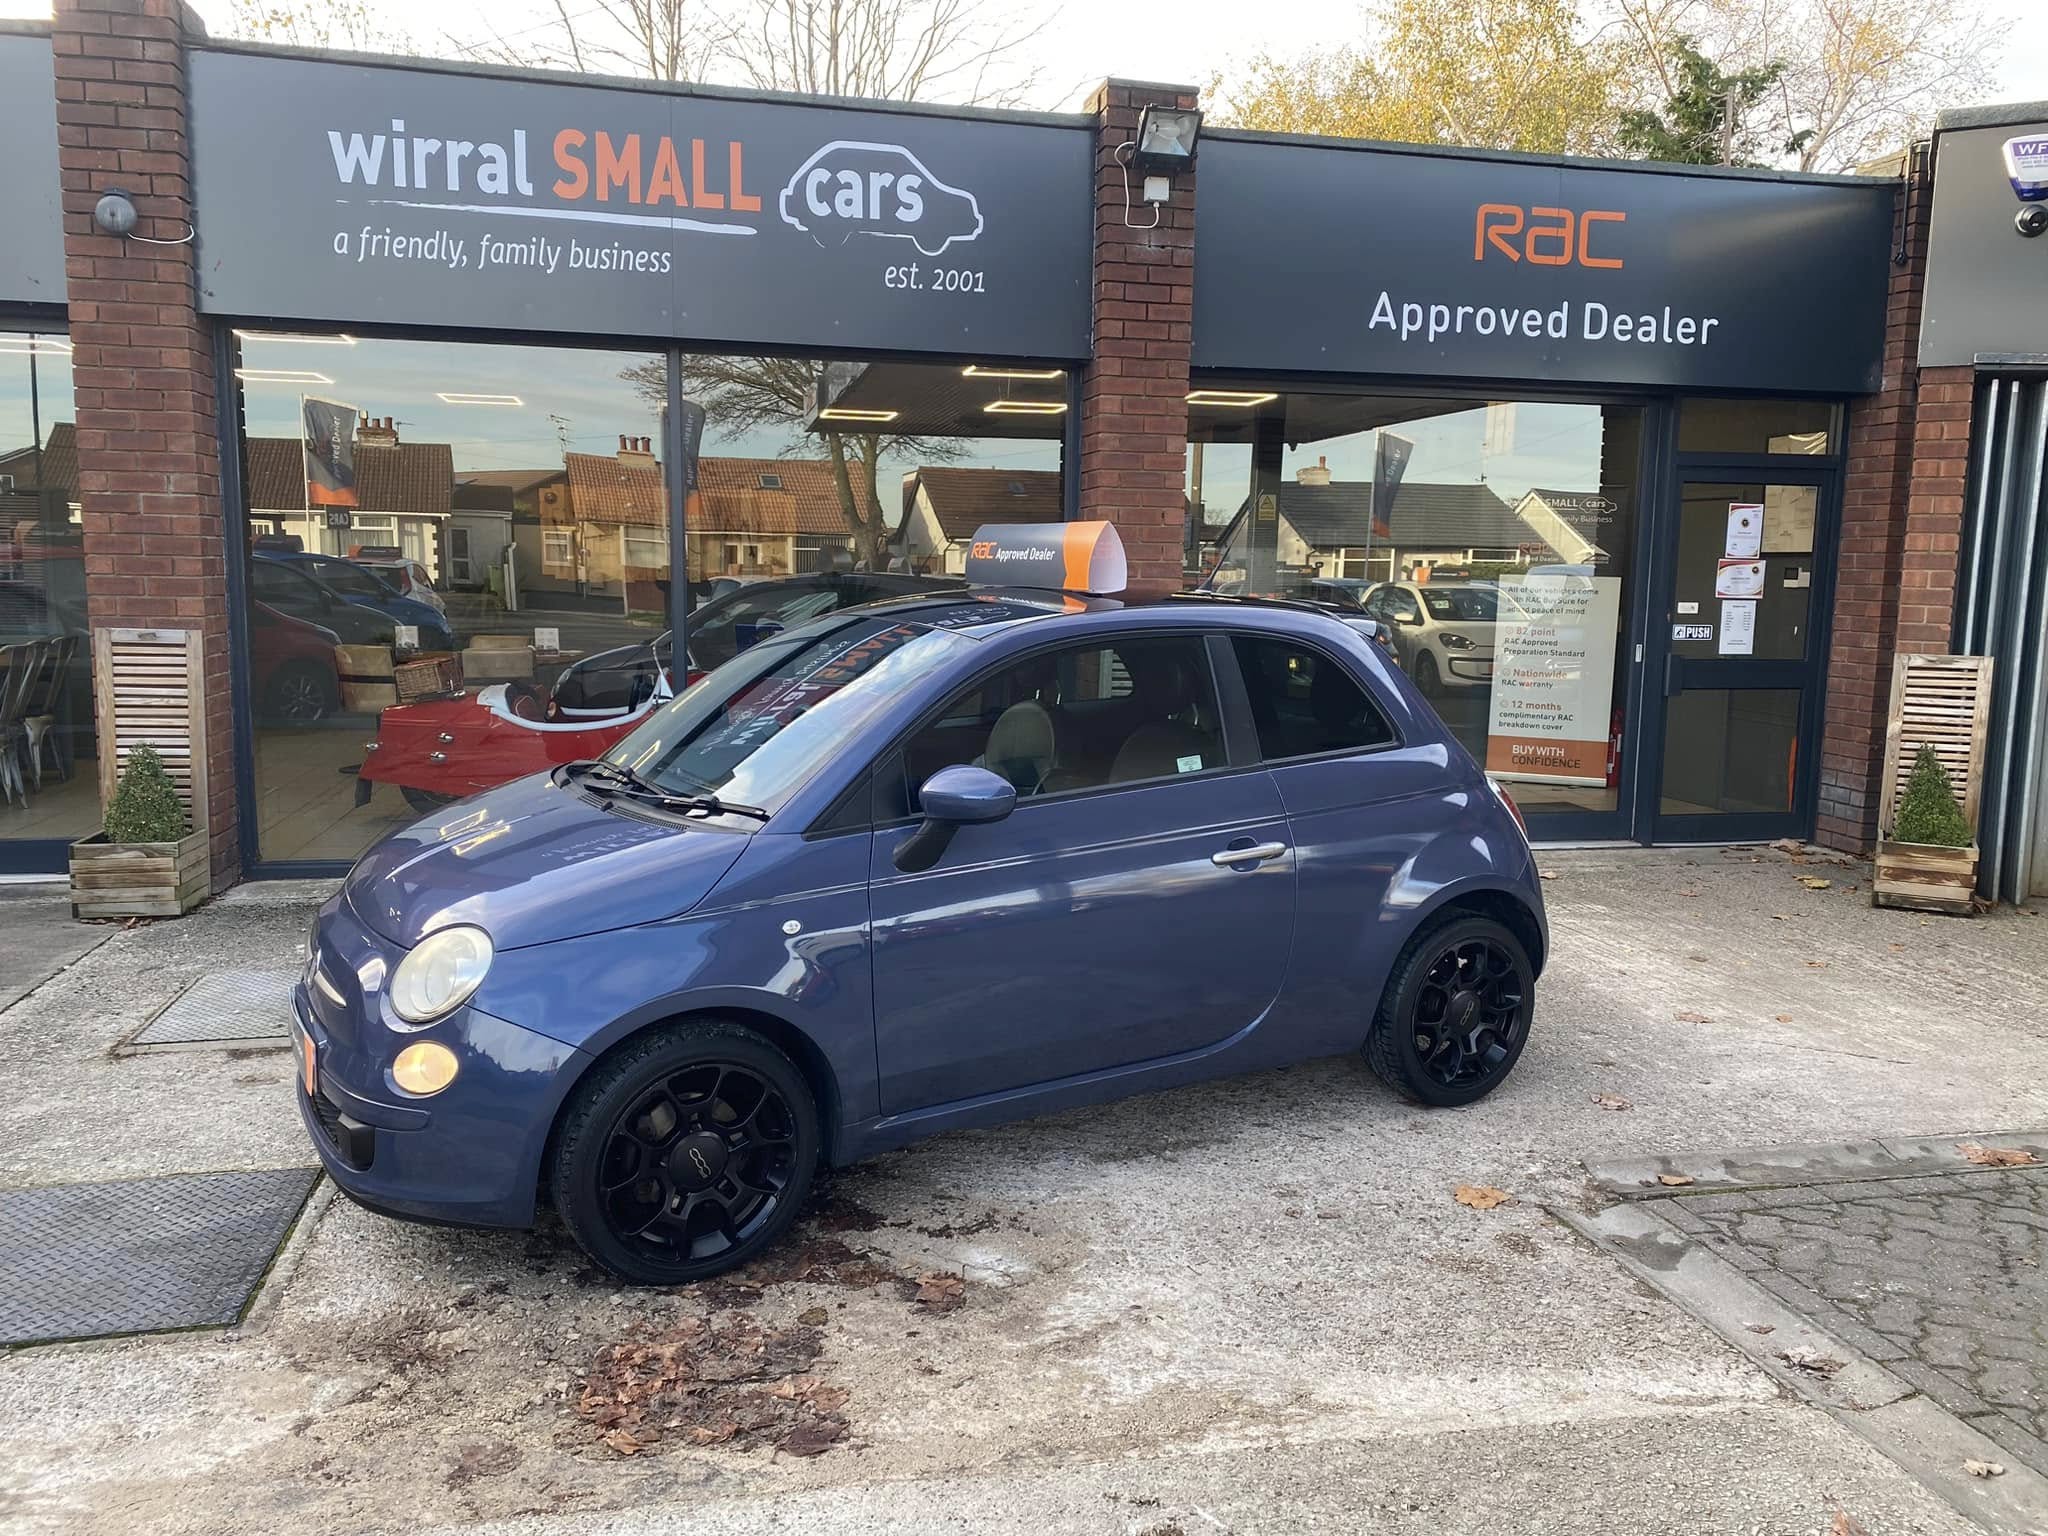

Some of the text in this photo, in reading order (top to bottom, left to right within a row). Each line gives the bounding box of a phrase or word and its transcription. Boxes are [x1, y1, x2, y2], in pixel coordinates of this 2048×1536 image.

[327, 118, 761, 212] wirral SMALL
[806, 167, 924, 222] cars
[333, 226, 672, 274] a friendly, family business
[884, 262, 985, 293] est. 2001
[1368, 291, 1720, 345] Approved Dealer
[995, 547, 1029, 563] Approved
[1029, 547, 1055, 561] Dealer
[1530, 627, 1556, 637] point
[1686, 626, 1710, 639] PUSH
[1522, 638, 1559, 647] Approved
[1503, 647, 1586, 658] Preparation Standard
[1513, 668, 1568, 680] Nationwide
[1519, 680, 1554, 689] warranty
[1511, 700, 1562, 712] 12 months
[1499, 711, 1574, 722] complimentary RAC
[1498, 721, 1564, 731] breakdown cover
[1512, 744, 1565, 757] BUY WITH
[1511, 755, 1581, 769] CONFIDENCE
